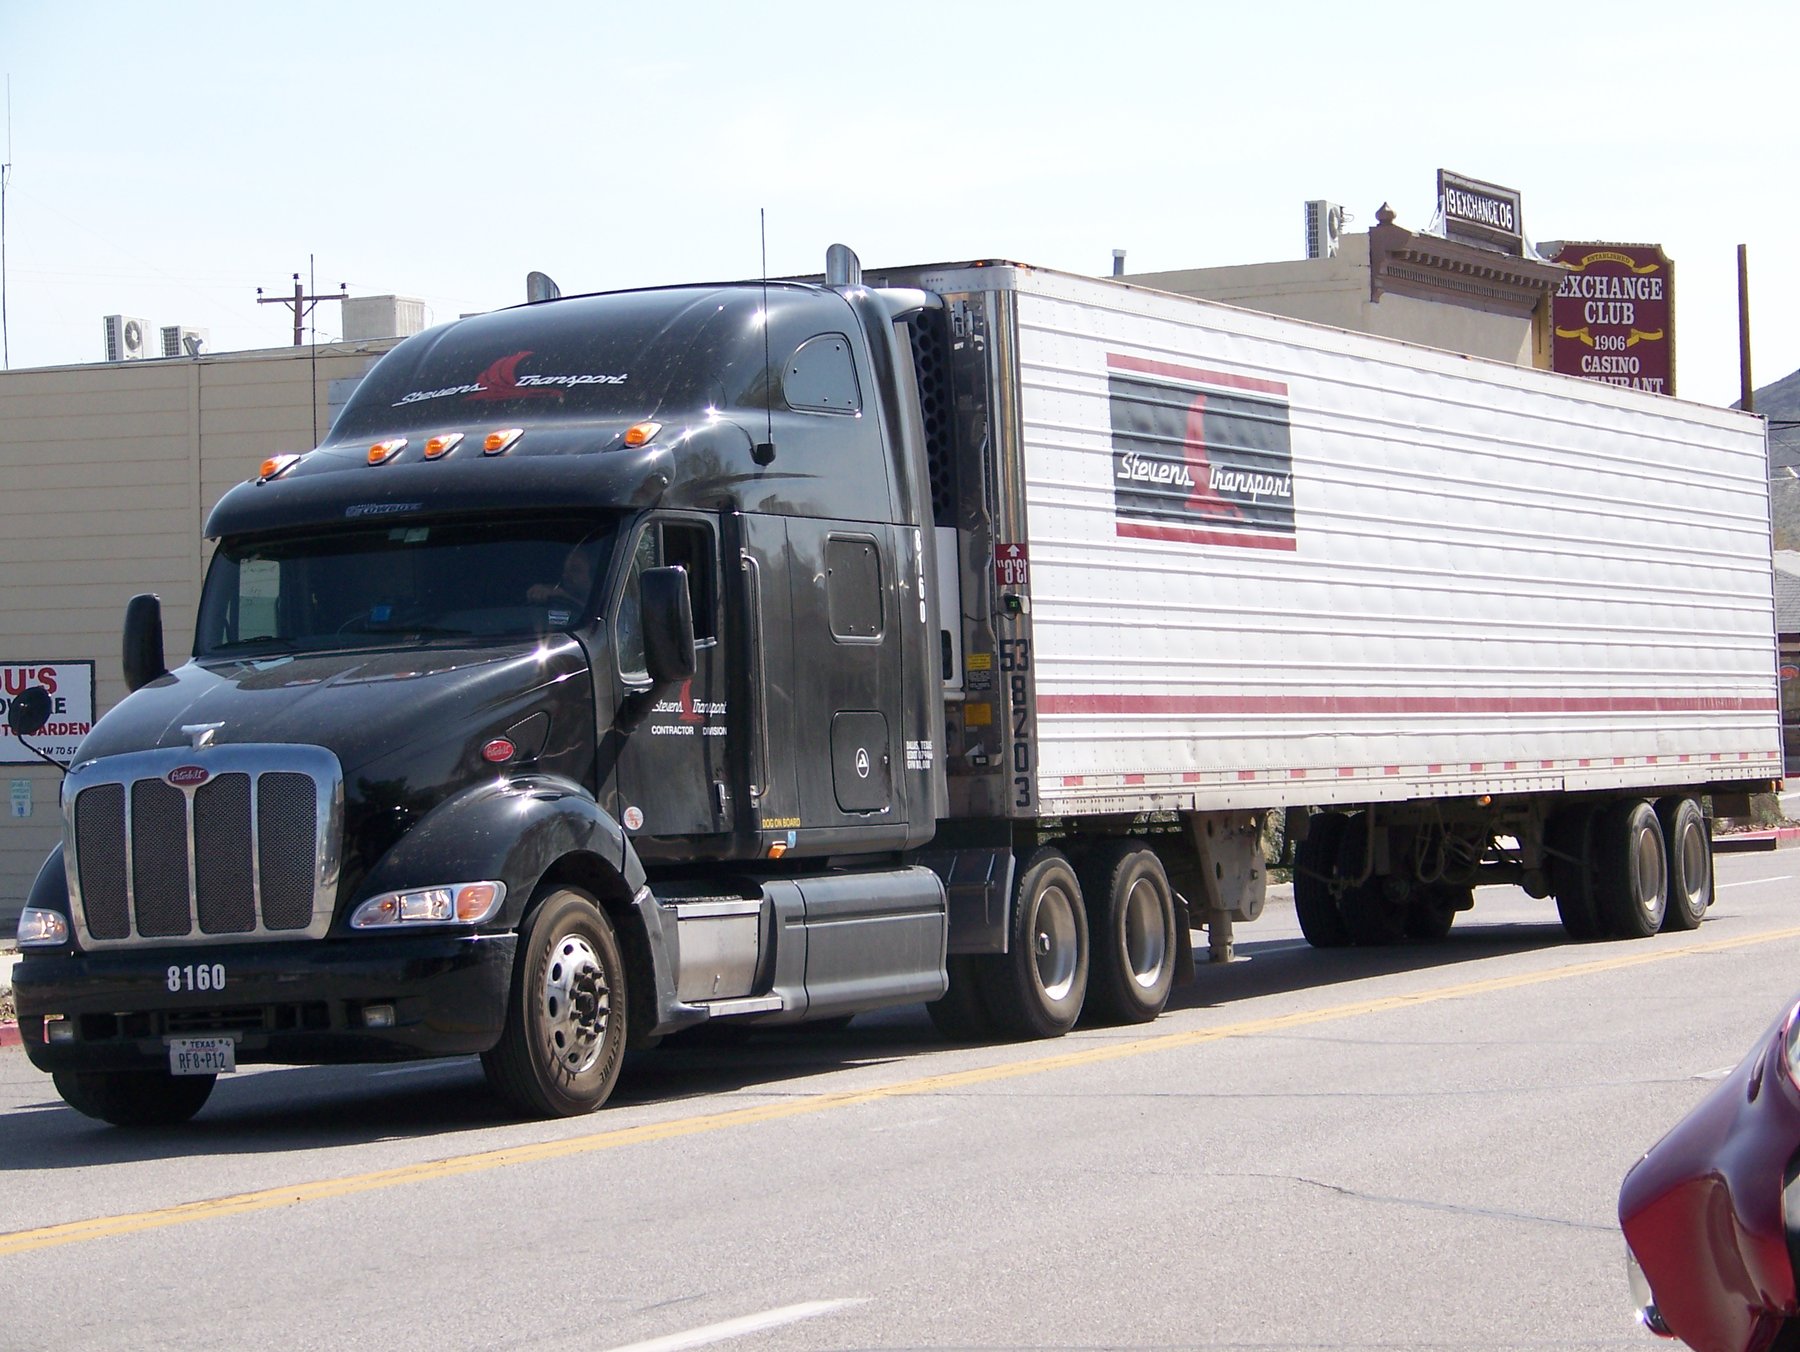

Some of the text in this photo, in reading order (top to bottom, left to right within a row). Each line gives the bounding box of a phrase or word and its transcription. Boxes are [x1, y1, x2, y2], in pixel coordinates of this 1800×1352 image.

[1446, 187, 1456, 214] 19
[1500, 203, 1513, 229] 06
[1556, 275, 1662, 300] EXCHANGE
[1584, 301, 1635, 325] CLUB
[1594, 335, 1625, 351] 1906
[1581, 355, 1640, 374] CASINO
[392, 374, 628, 407] Stevens Transport
[1117, 452, 1291, 504] Stevens Transport
[28, 722, 90, 736] ARDEN
[651, 725, 728, 736] CONTRACTOR DIVISION
[56, 746, 66, 755] TO
[762, 818, 774, 829] DOG
[167, 964, 226, 992] 8160
[190, 1040, 216, 1049] TEXAS
